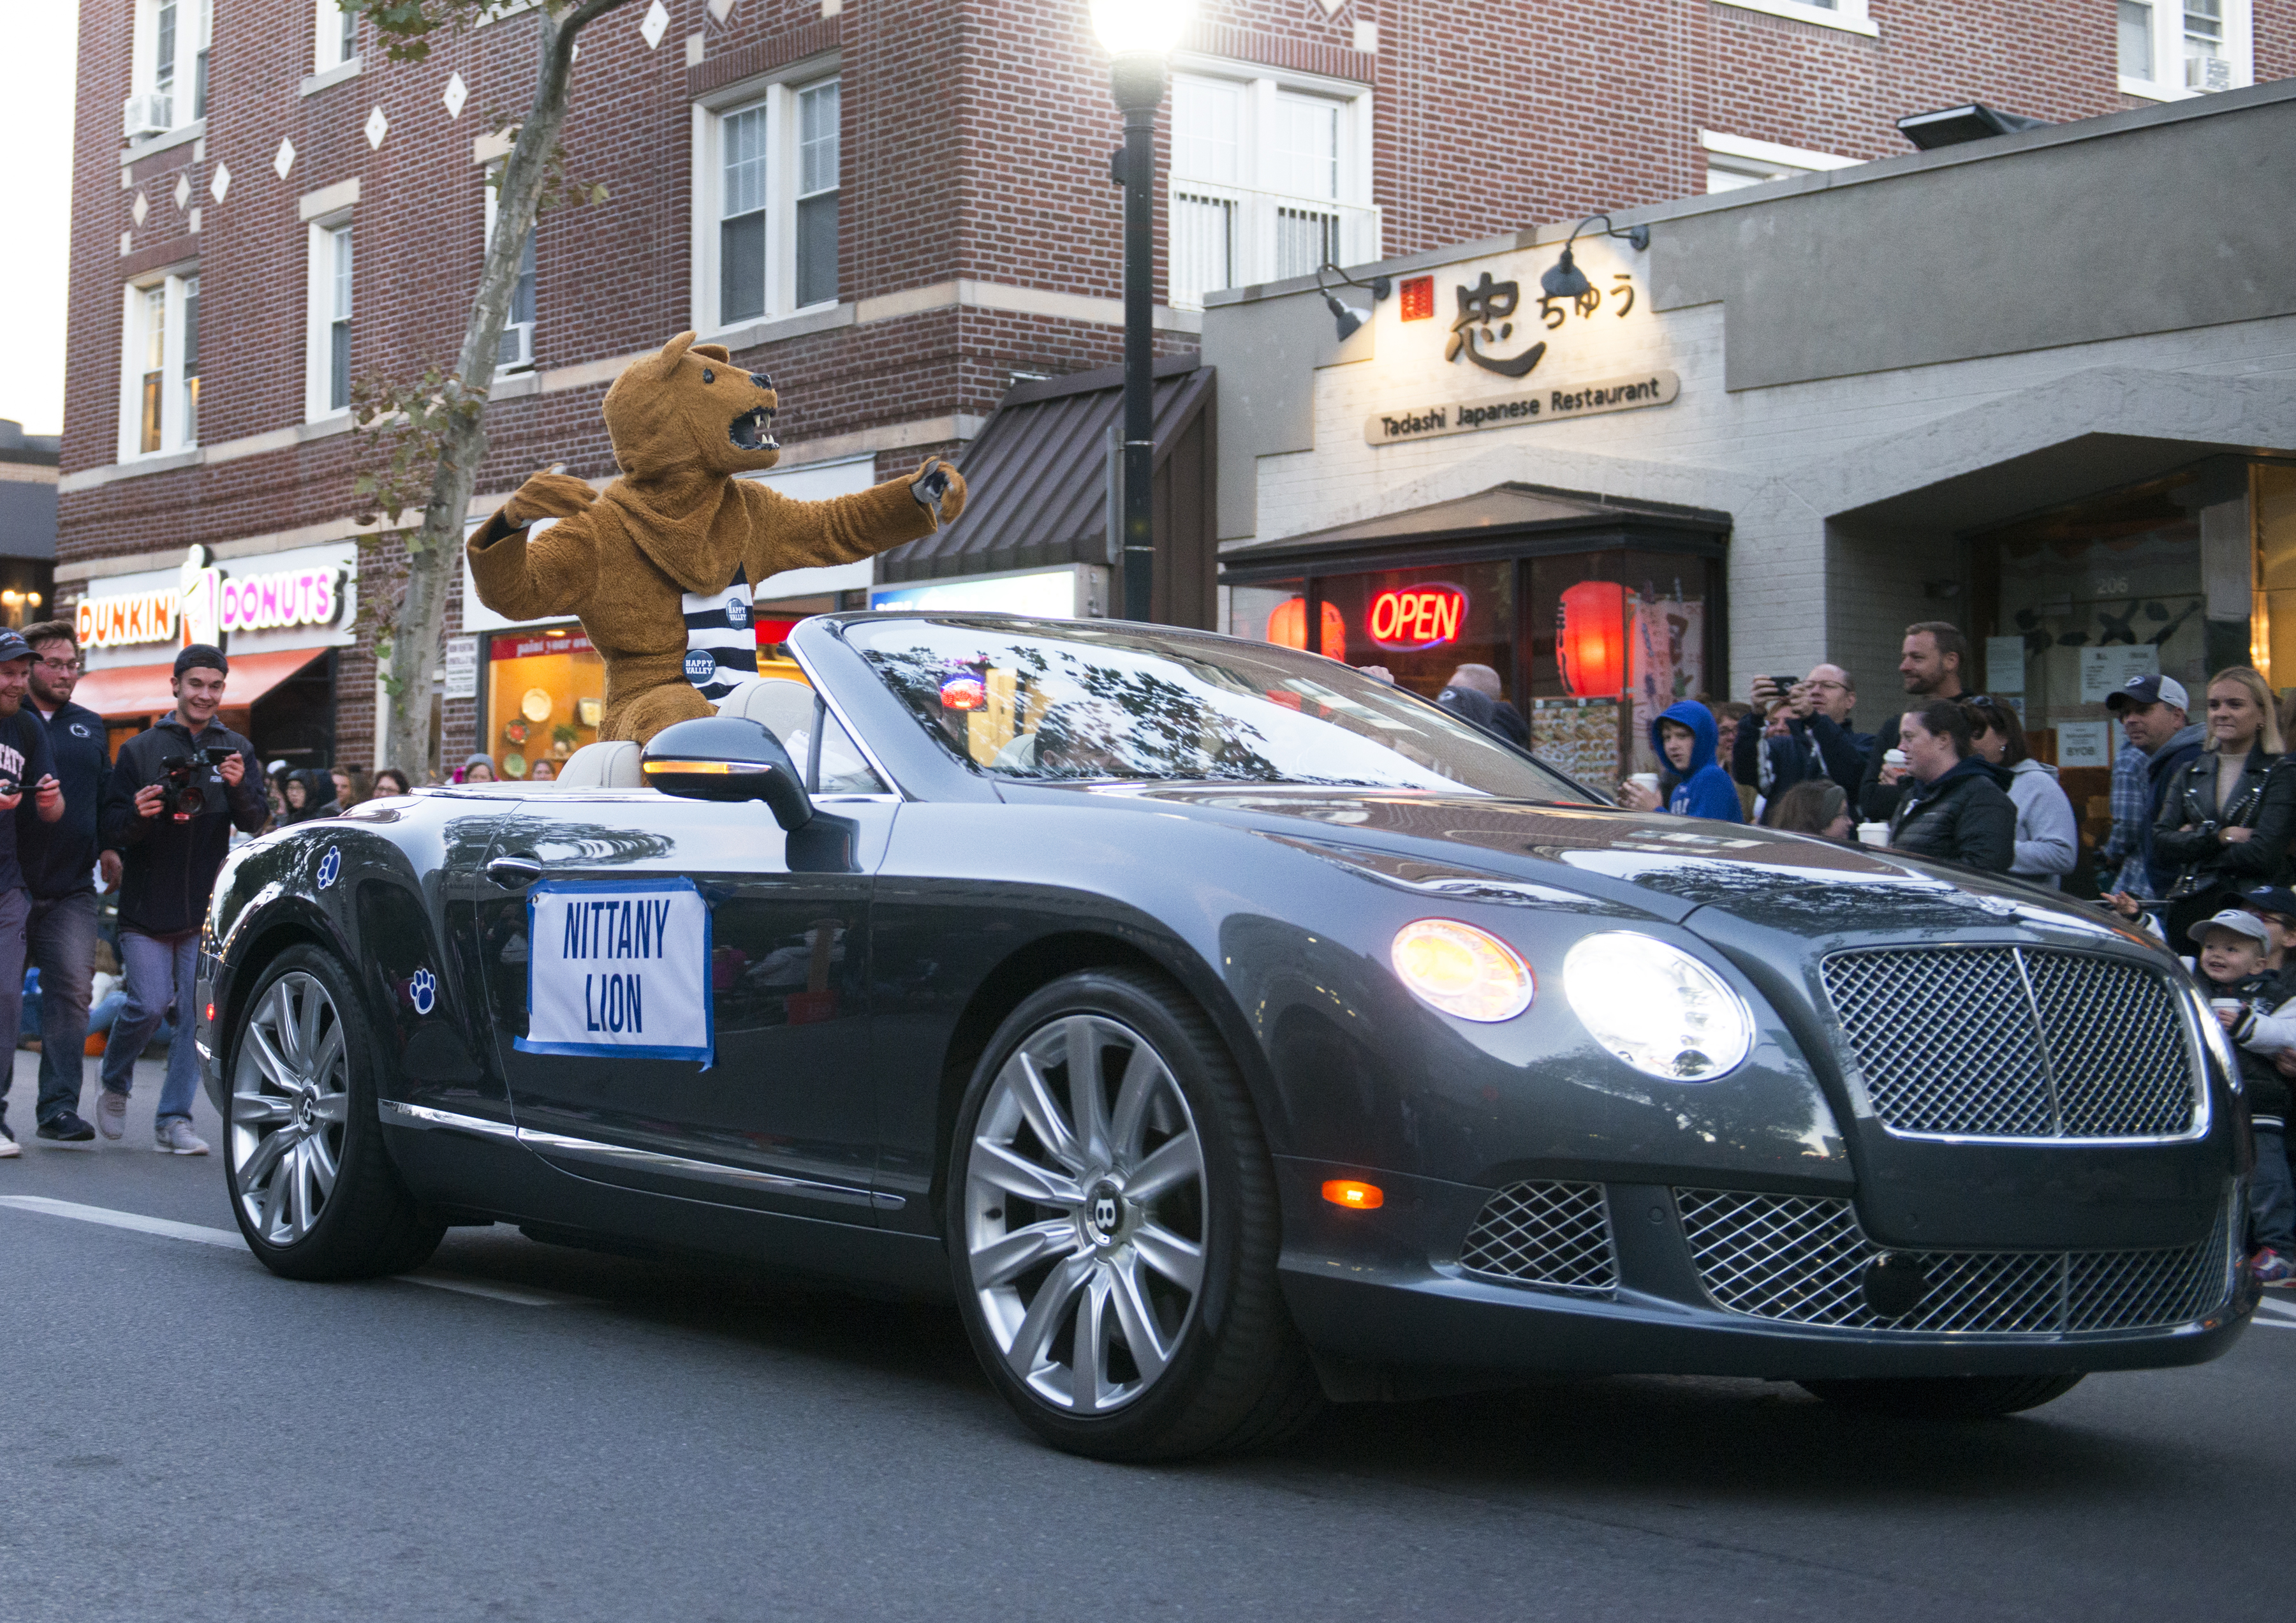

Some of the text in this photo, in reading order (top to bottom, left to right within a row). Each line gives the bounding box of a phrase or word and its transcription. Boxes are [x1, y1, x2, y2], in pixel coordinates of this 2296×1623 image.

[1445, 270, 1547, 378] 忠
[1381, 376, 1659, 437] Tadashi Japanese Restaurant
[78, 573, 330, 644] DUNKIN' DONUTS
[728, 606, 746, 614] HAPPY
[1372, 592, 1461, 640] OPEN
[563, 899, 671, 960] NITTANY
[585, 973, 643, 1034] LION
